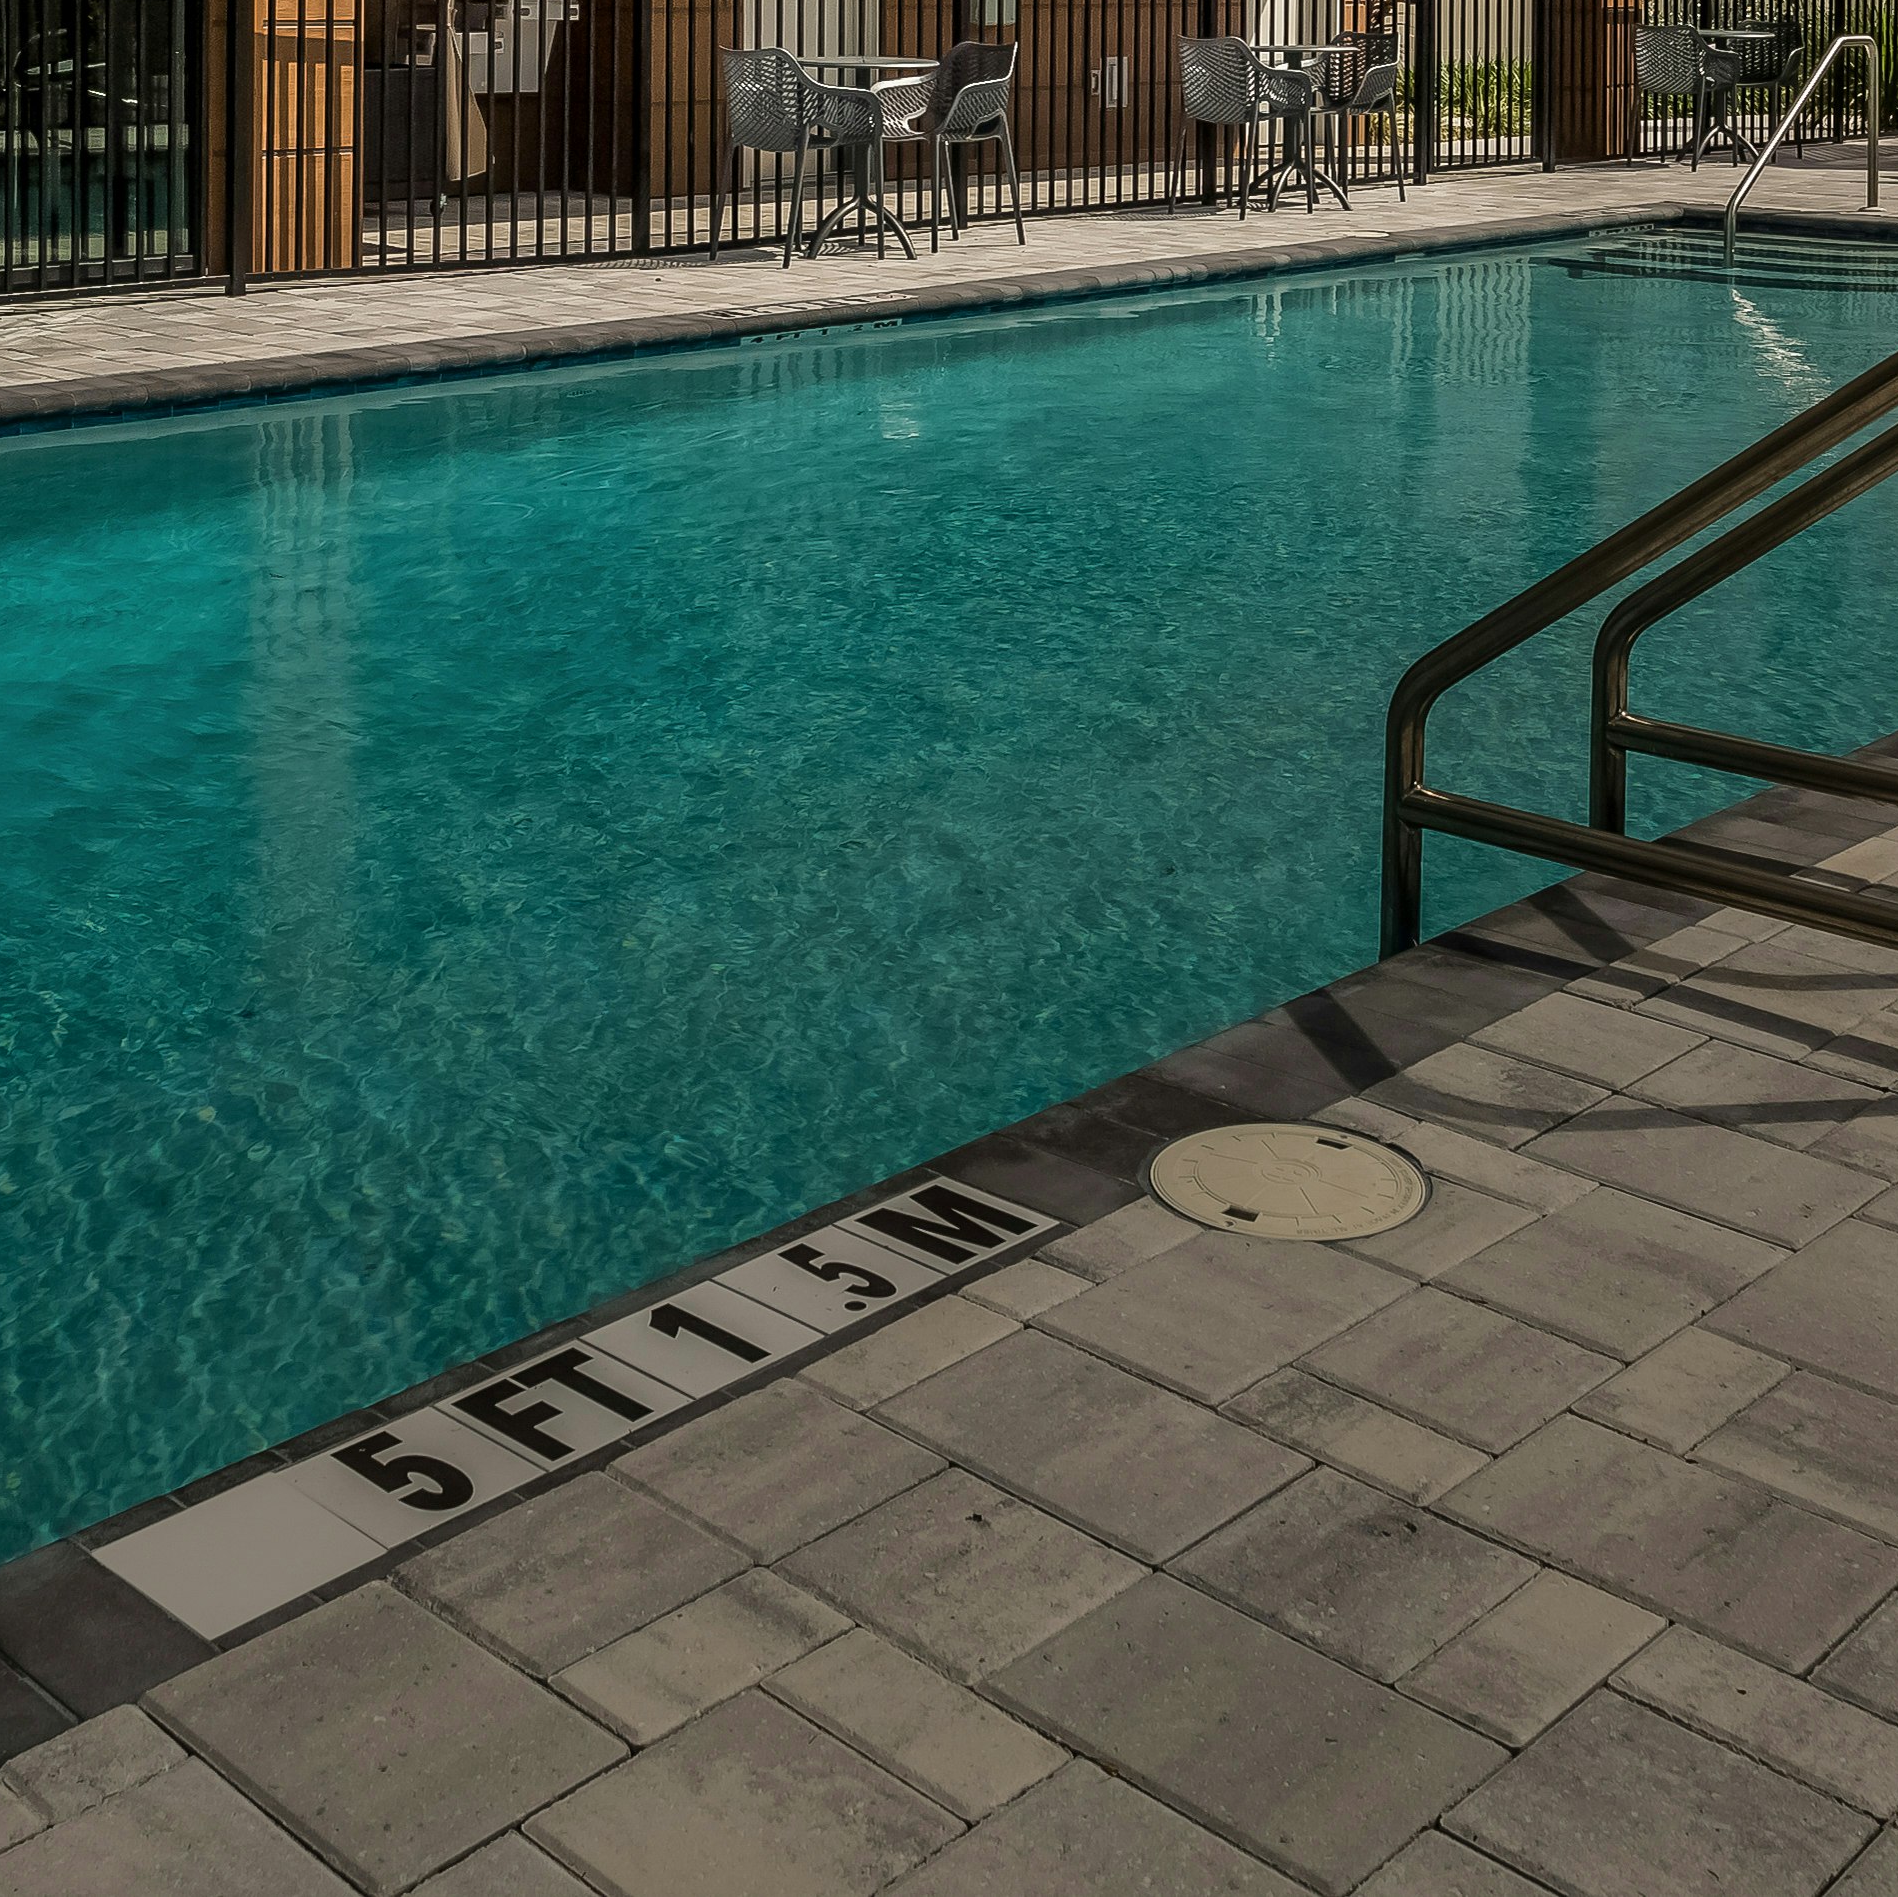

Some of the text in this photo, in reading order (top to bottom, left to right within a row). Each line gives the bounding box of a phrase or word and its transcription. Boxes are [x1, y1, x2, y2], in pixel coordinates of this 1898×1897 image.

[329, 1430, 475, 1512] 5
[450, 1346, 655, 1462] FT
[853, 1183, 1040, 1265] M
